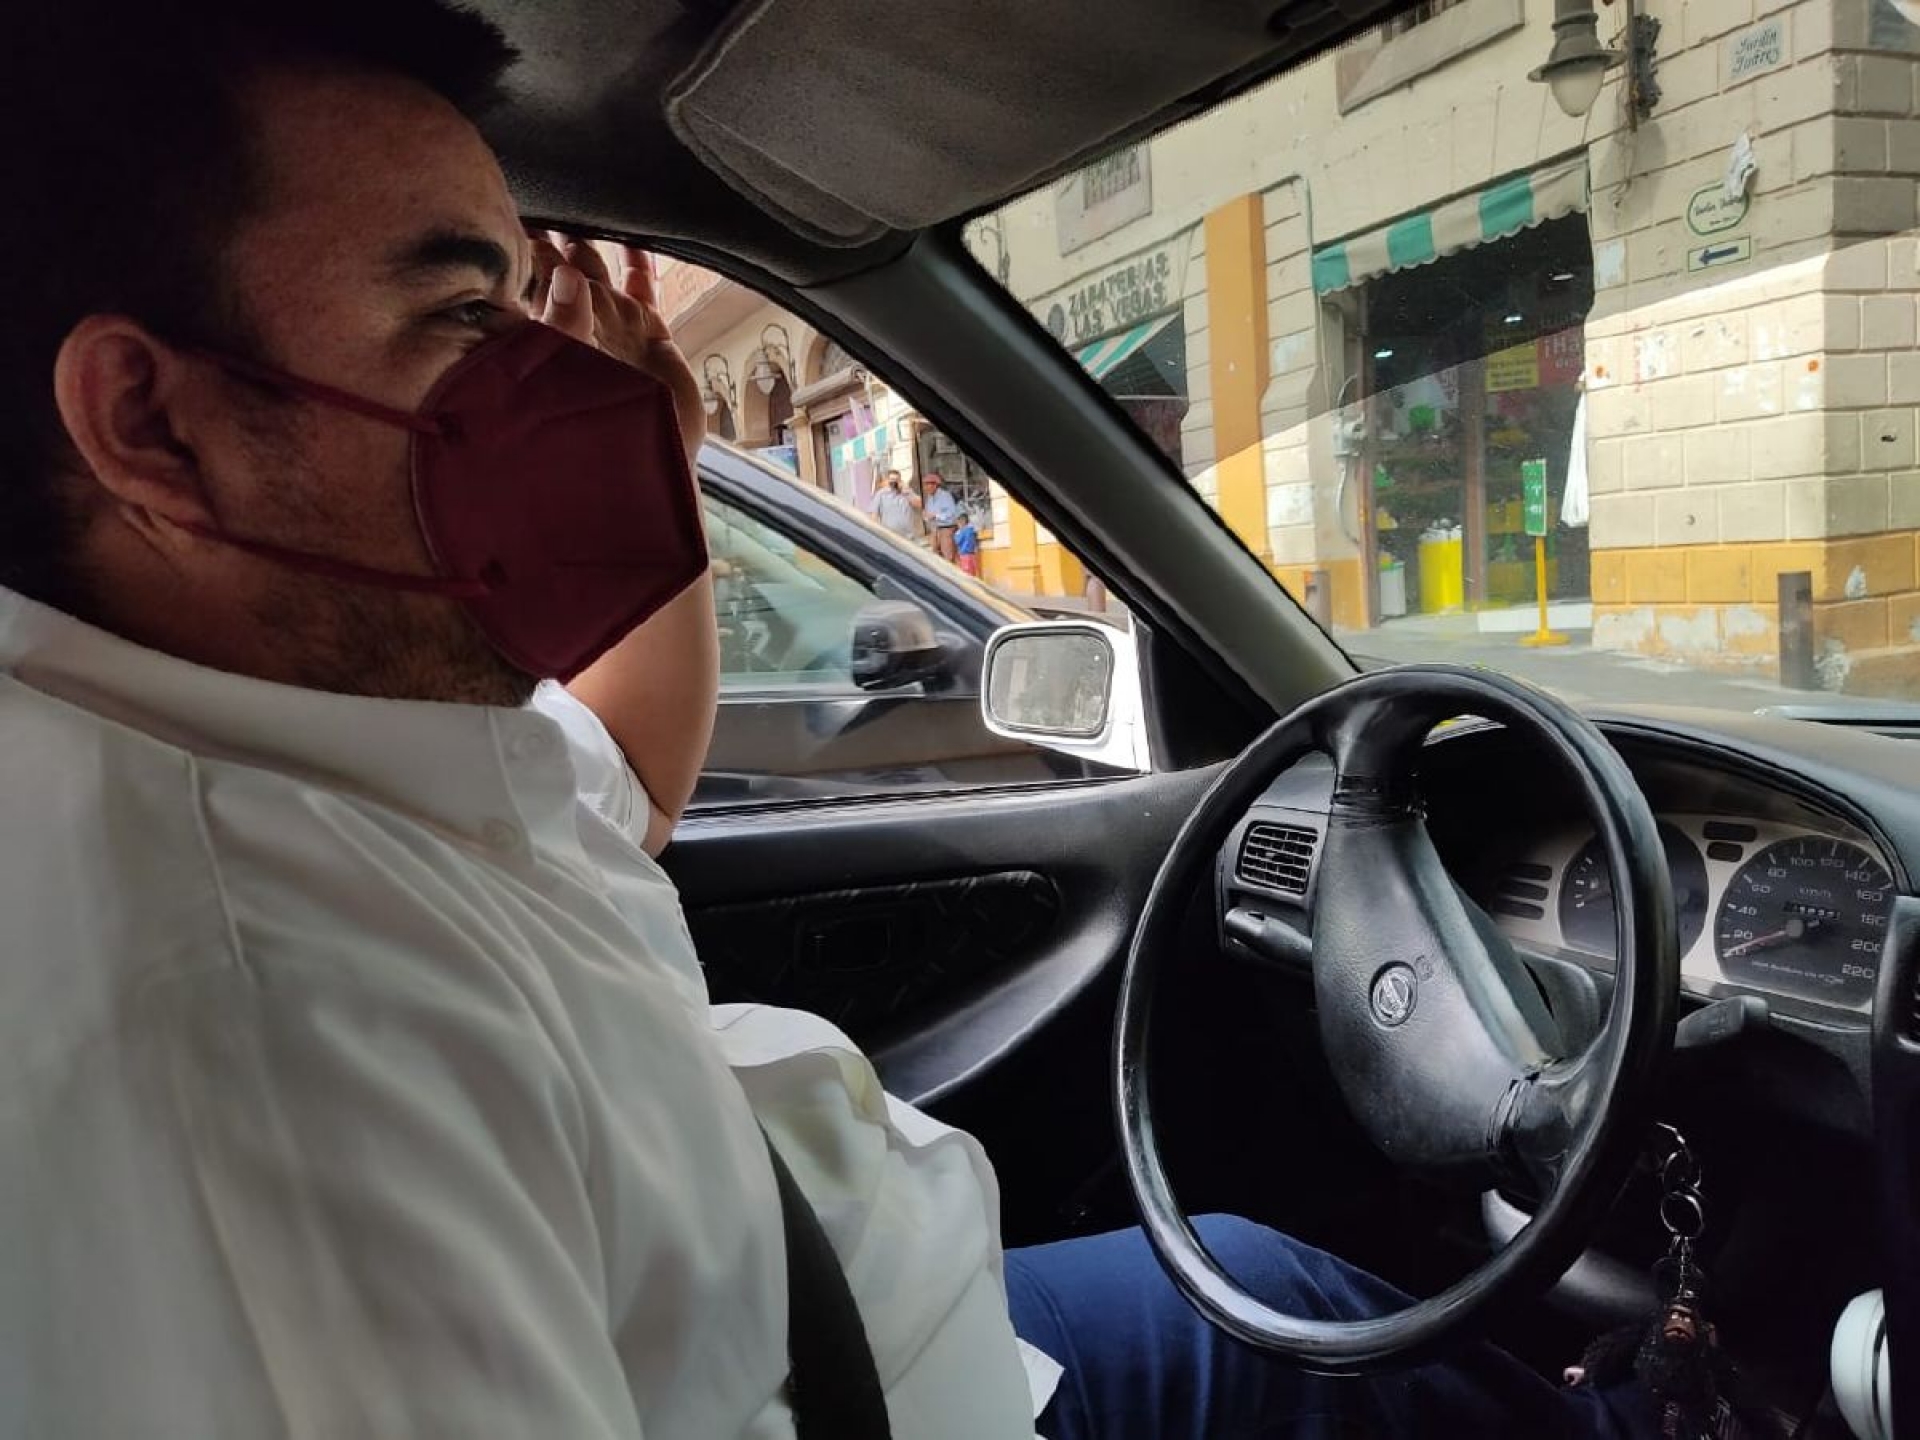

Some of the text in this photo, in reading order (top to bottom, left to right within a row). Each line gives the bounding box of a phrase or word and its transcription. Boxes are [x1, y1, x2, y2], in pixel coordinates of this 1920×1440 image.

[1068, 252, 1170, 316] ZAPATERIAS
[1073, 281, 1168, 339] LAS VEGAS
[1791, 857, 1814, 867] 100
[1820, 857, 1845, 868] 120
[1767, 868, 1787, 878] 80
[1845, 870, 1871, 882] 140
[1856, 889, 1883, 901] 160
[1738, 906, 1758, 916] 40
[1733, 930, 1753, 940] 20
[1842, 964, 1875, 979] 220
